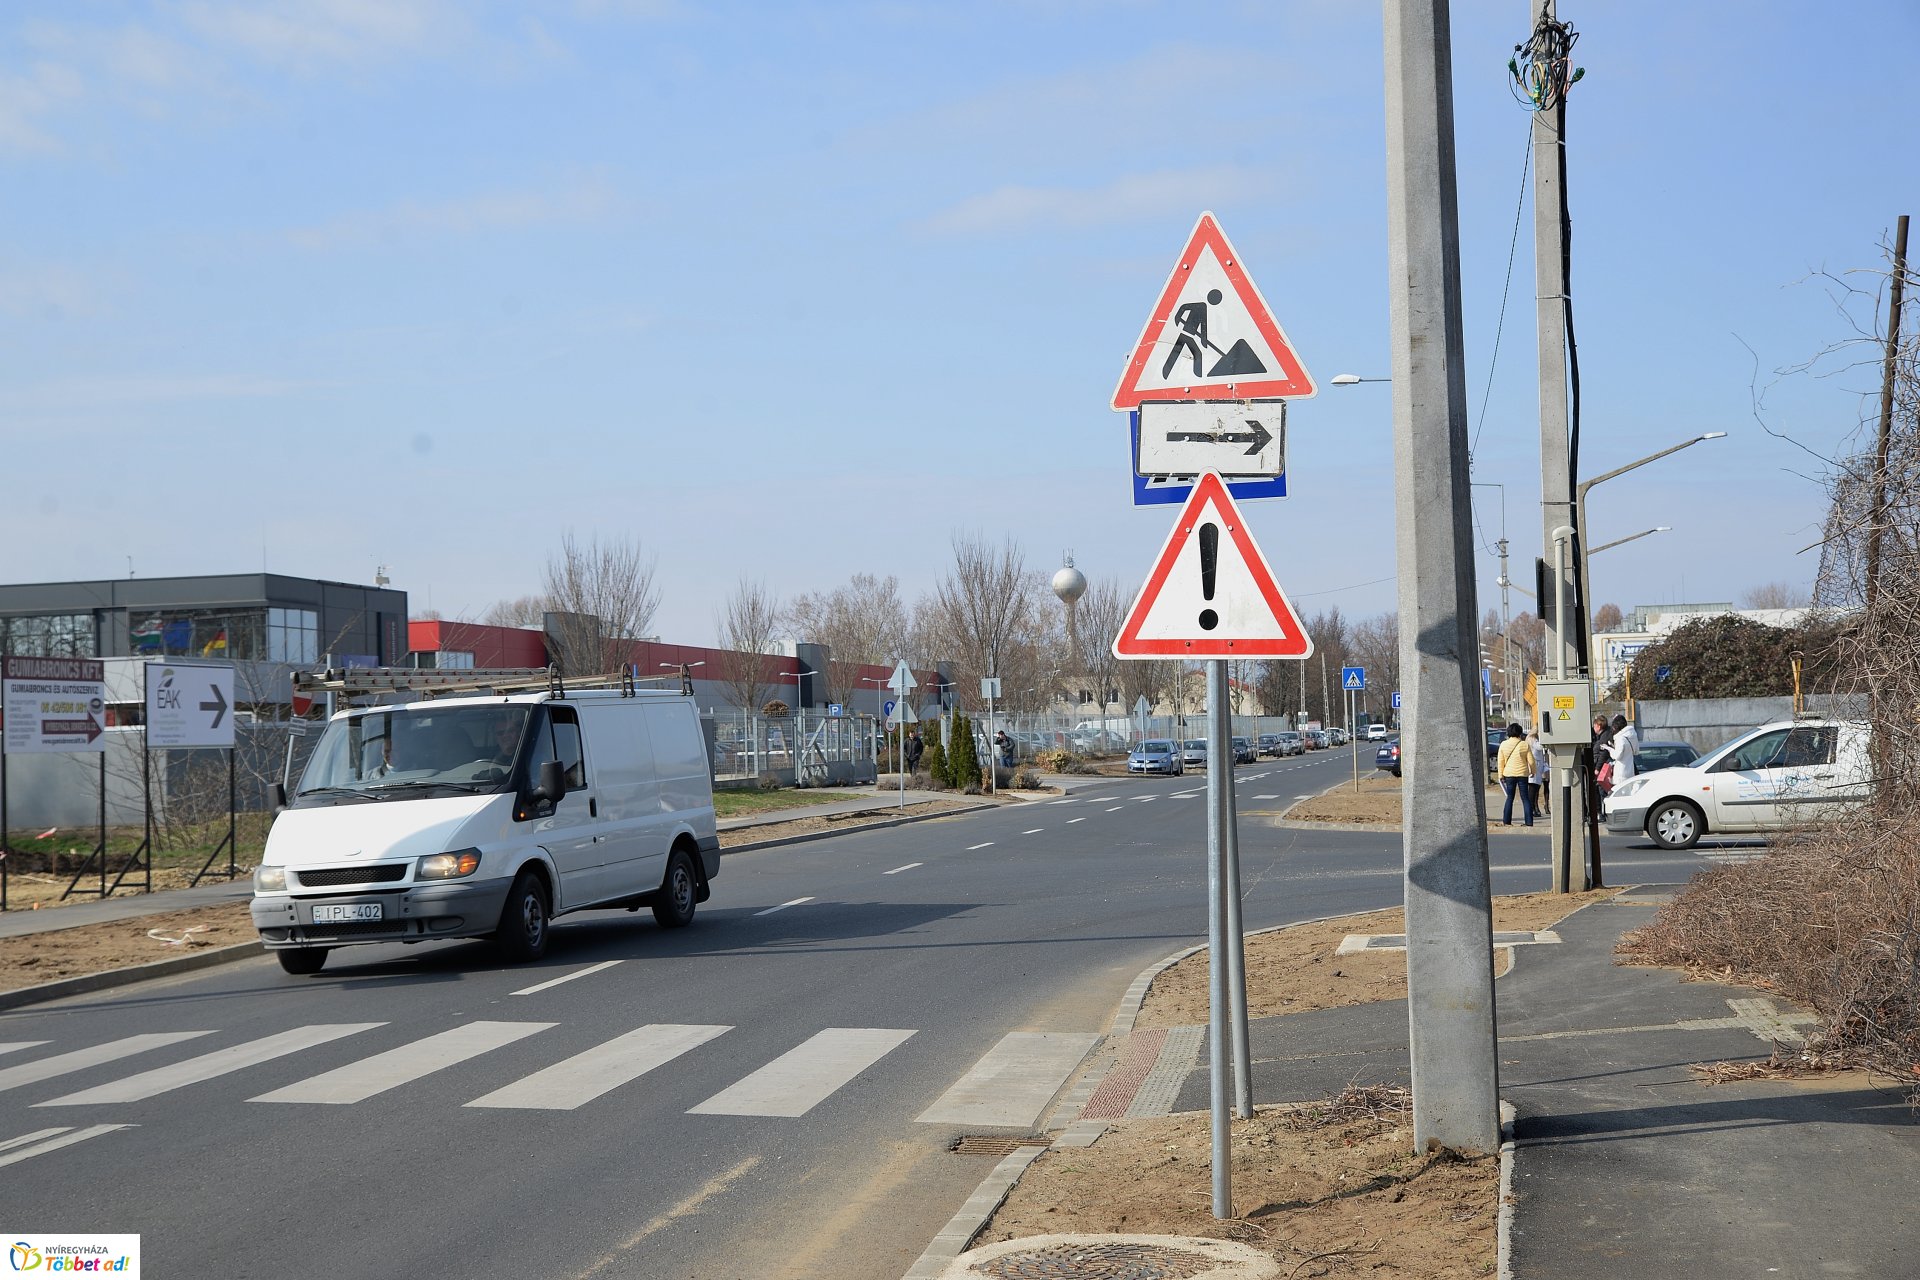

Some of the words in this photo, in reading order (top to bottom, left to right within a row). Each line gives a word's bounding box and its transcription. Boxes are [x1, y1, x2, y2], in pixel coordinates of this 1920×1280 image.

[8, 658, 80, 678] GUMIABRONCS
[82, 662, 102, 679] KFT.
[11, 684, 52, 693] GUMIABRONCS
[831, 706, 839, 716] P
[327, 905, 380, 919] IPL-402
